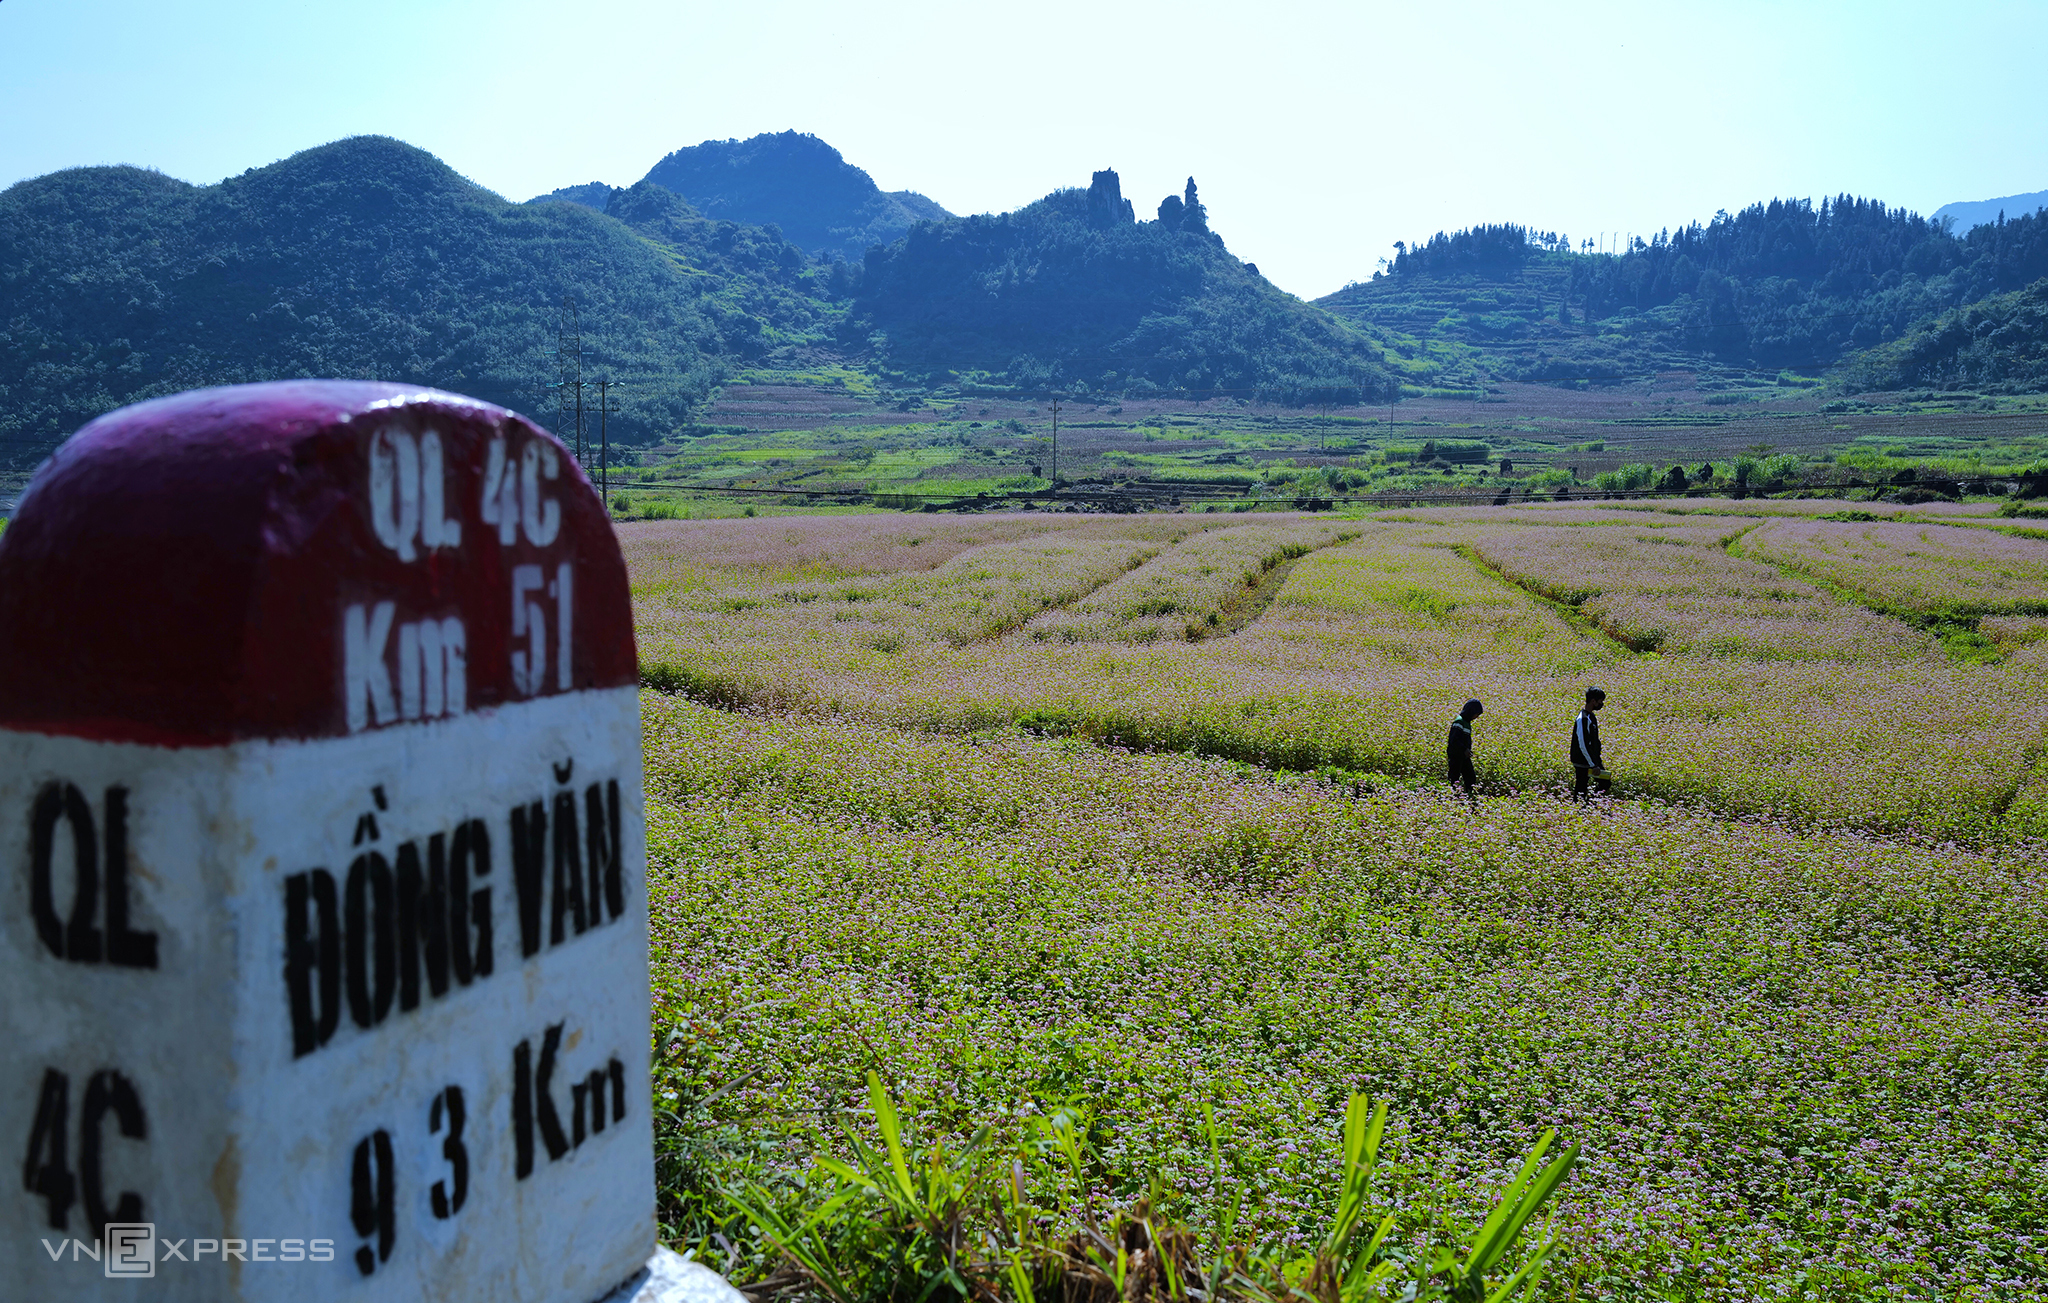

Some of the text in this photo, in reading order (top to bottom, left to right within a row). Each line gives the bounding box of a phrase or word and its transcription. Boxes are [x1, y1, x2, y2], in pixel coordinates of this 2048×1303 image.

[368, 428, 561, 563] QL 4C
[343, 562, 573, 733] Km 51
[29, 780, 159, 971] QL
[284, 757, 624, 1060] ĐỒNG VĂN
[23, 1067, 147, 1245] 4C
[512, 1020, 626, 1182] Km
